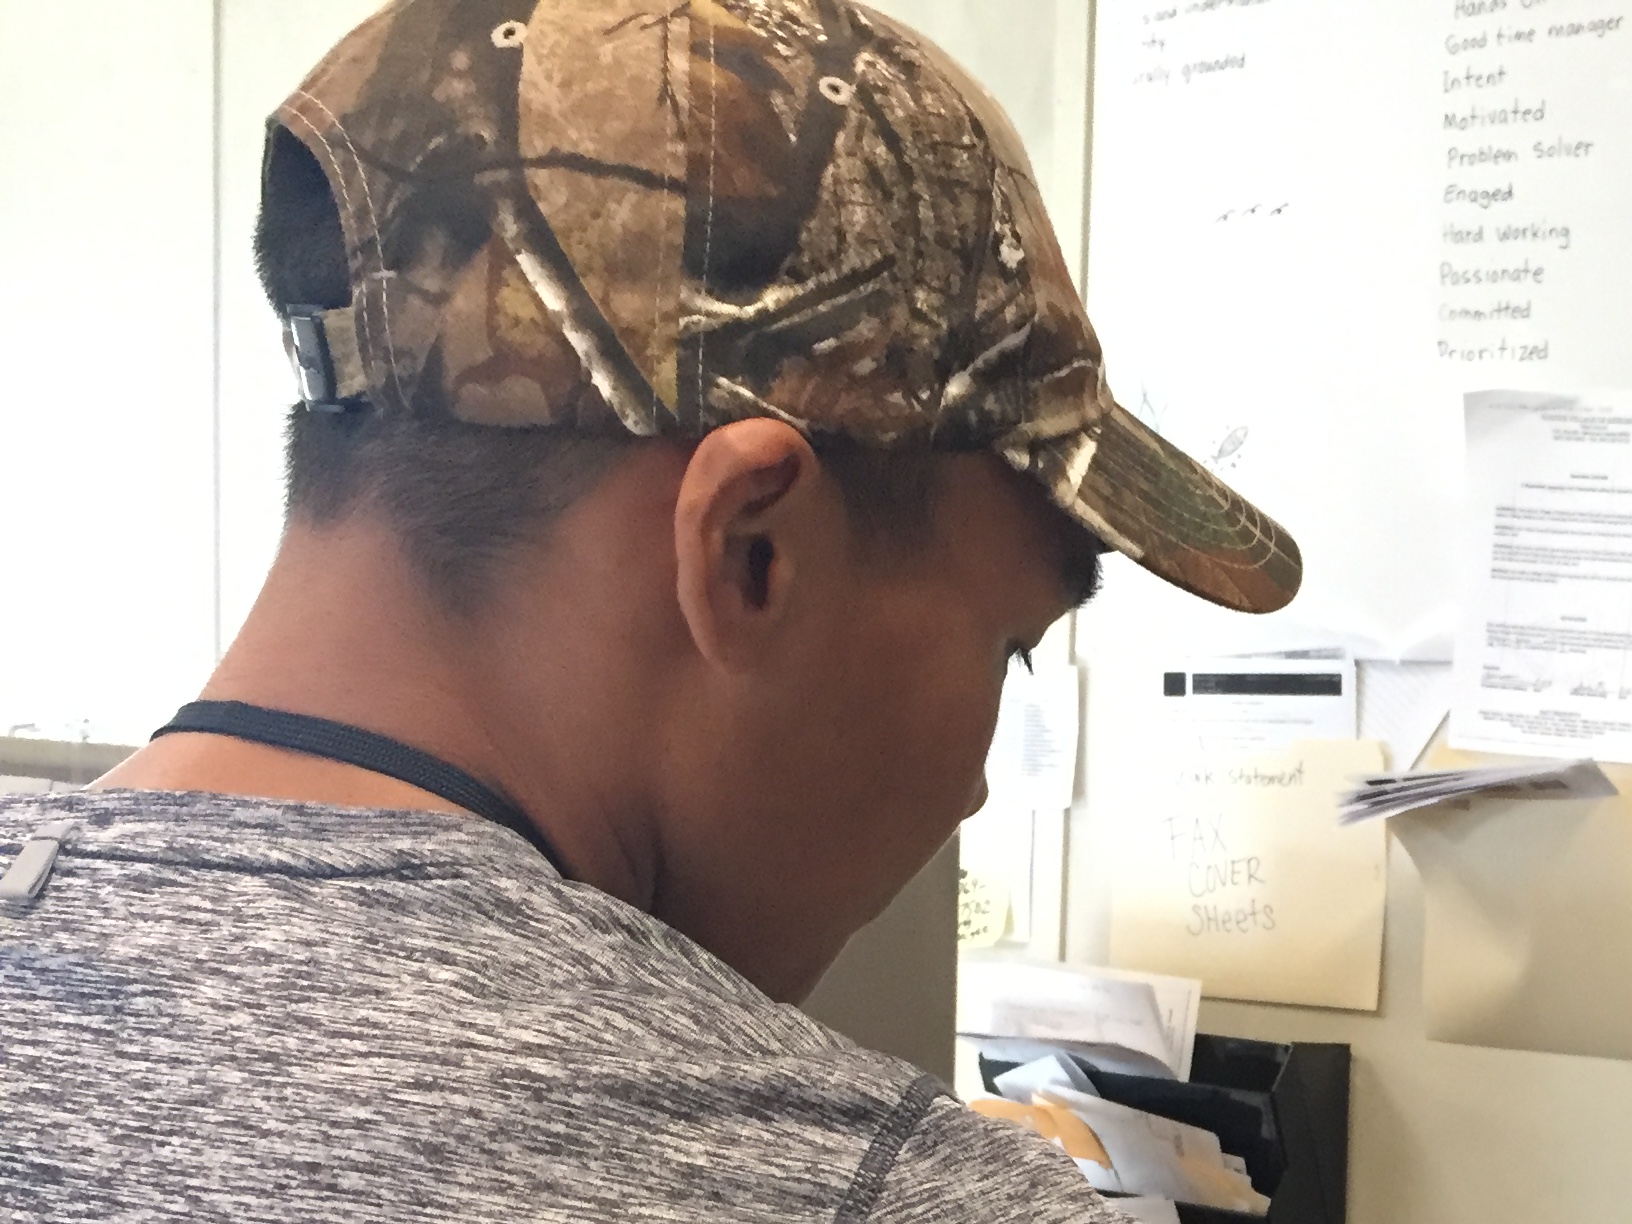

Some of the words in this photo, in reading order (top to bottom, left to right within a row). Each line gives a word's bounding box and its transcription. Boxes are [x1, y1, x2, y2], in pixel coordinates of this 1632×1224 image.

[1445, 30, 1488, 56] Good
[1496, 25, 1537, 46] time
[1547, 15, 1625, 38] manager
[1442, 64, 1508, 94] Intent
[1442, 97, 1547, 130] Motivated
[1447, 145, 1519, 169] Problem
[1442, 221, 1484, 244] Hard
[1439, 257, 1546, 287] Passionate
[1438, 299, 1533, 322] Committed
[1436, 336, 1550, 362] Prioritized
[1162, 812, 1228, 860] FAX
[1188, 856, 1266, 898] COVER
